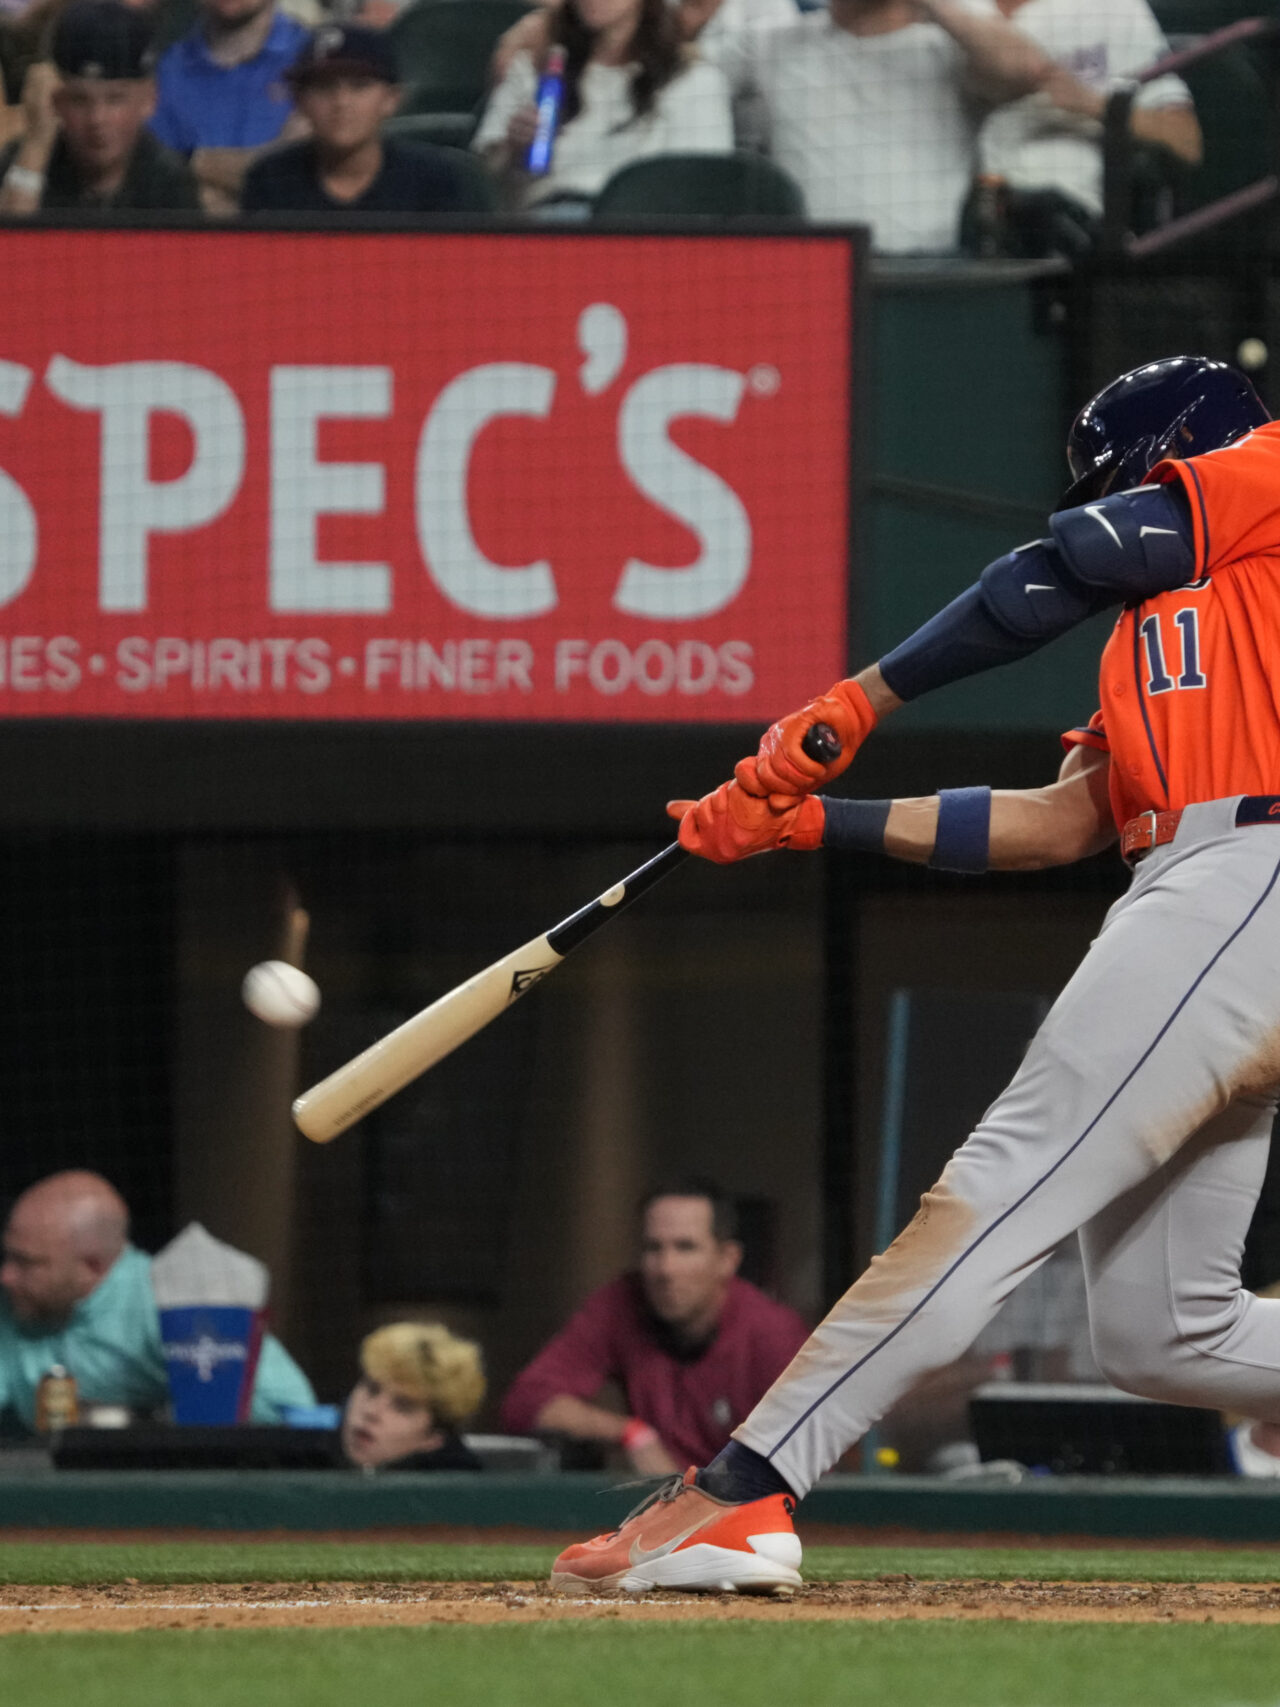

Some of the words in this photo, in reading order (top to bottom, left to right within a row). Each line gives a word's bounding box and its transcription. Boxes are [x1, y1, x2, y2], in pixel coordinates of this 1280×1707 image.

[0, 303, 752, 620] PEC'S
[0, 636, 82, 692] ES
[116, 637, 332, 694] SPIRITS
[364, 638, 534, 694] FINER
[554, 639, 755, 695] FOODS
[1139, 607, 1207, 697] 11
